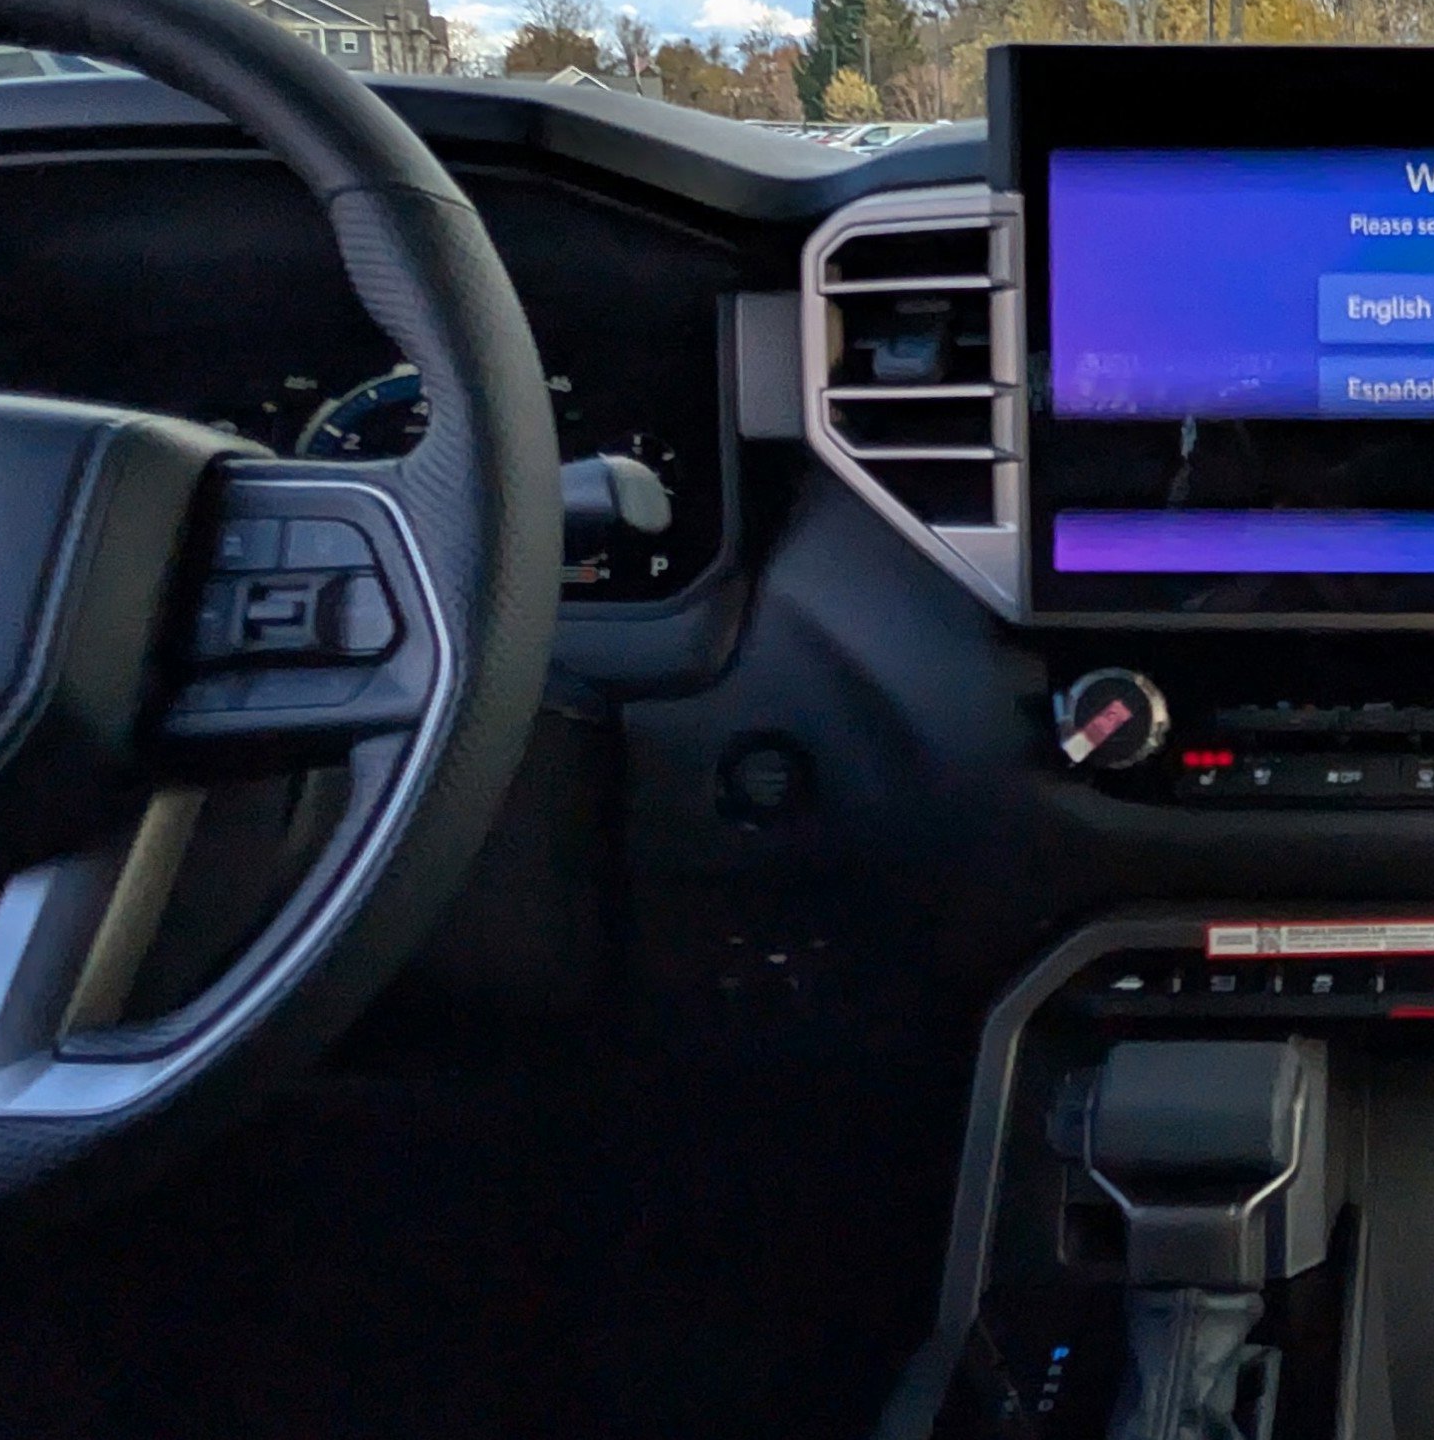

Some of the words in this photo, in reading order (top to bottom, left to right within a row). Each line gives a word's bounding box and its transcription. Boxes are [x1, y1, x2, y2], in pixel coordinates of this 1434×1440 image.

[1350, 215, 1413, 237] Please
[1347, 295, 1432, 326] English
[649, 555, 669, 577] P
